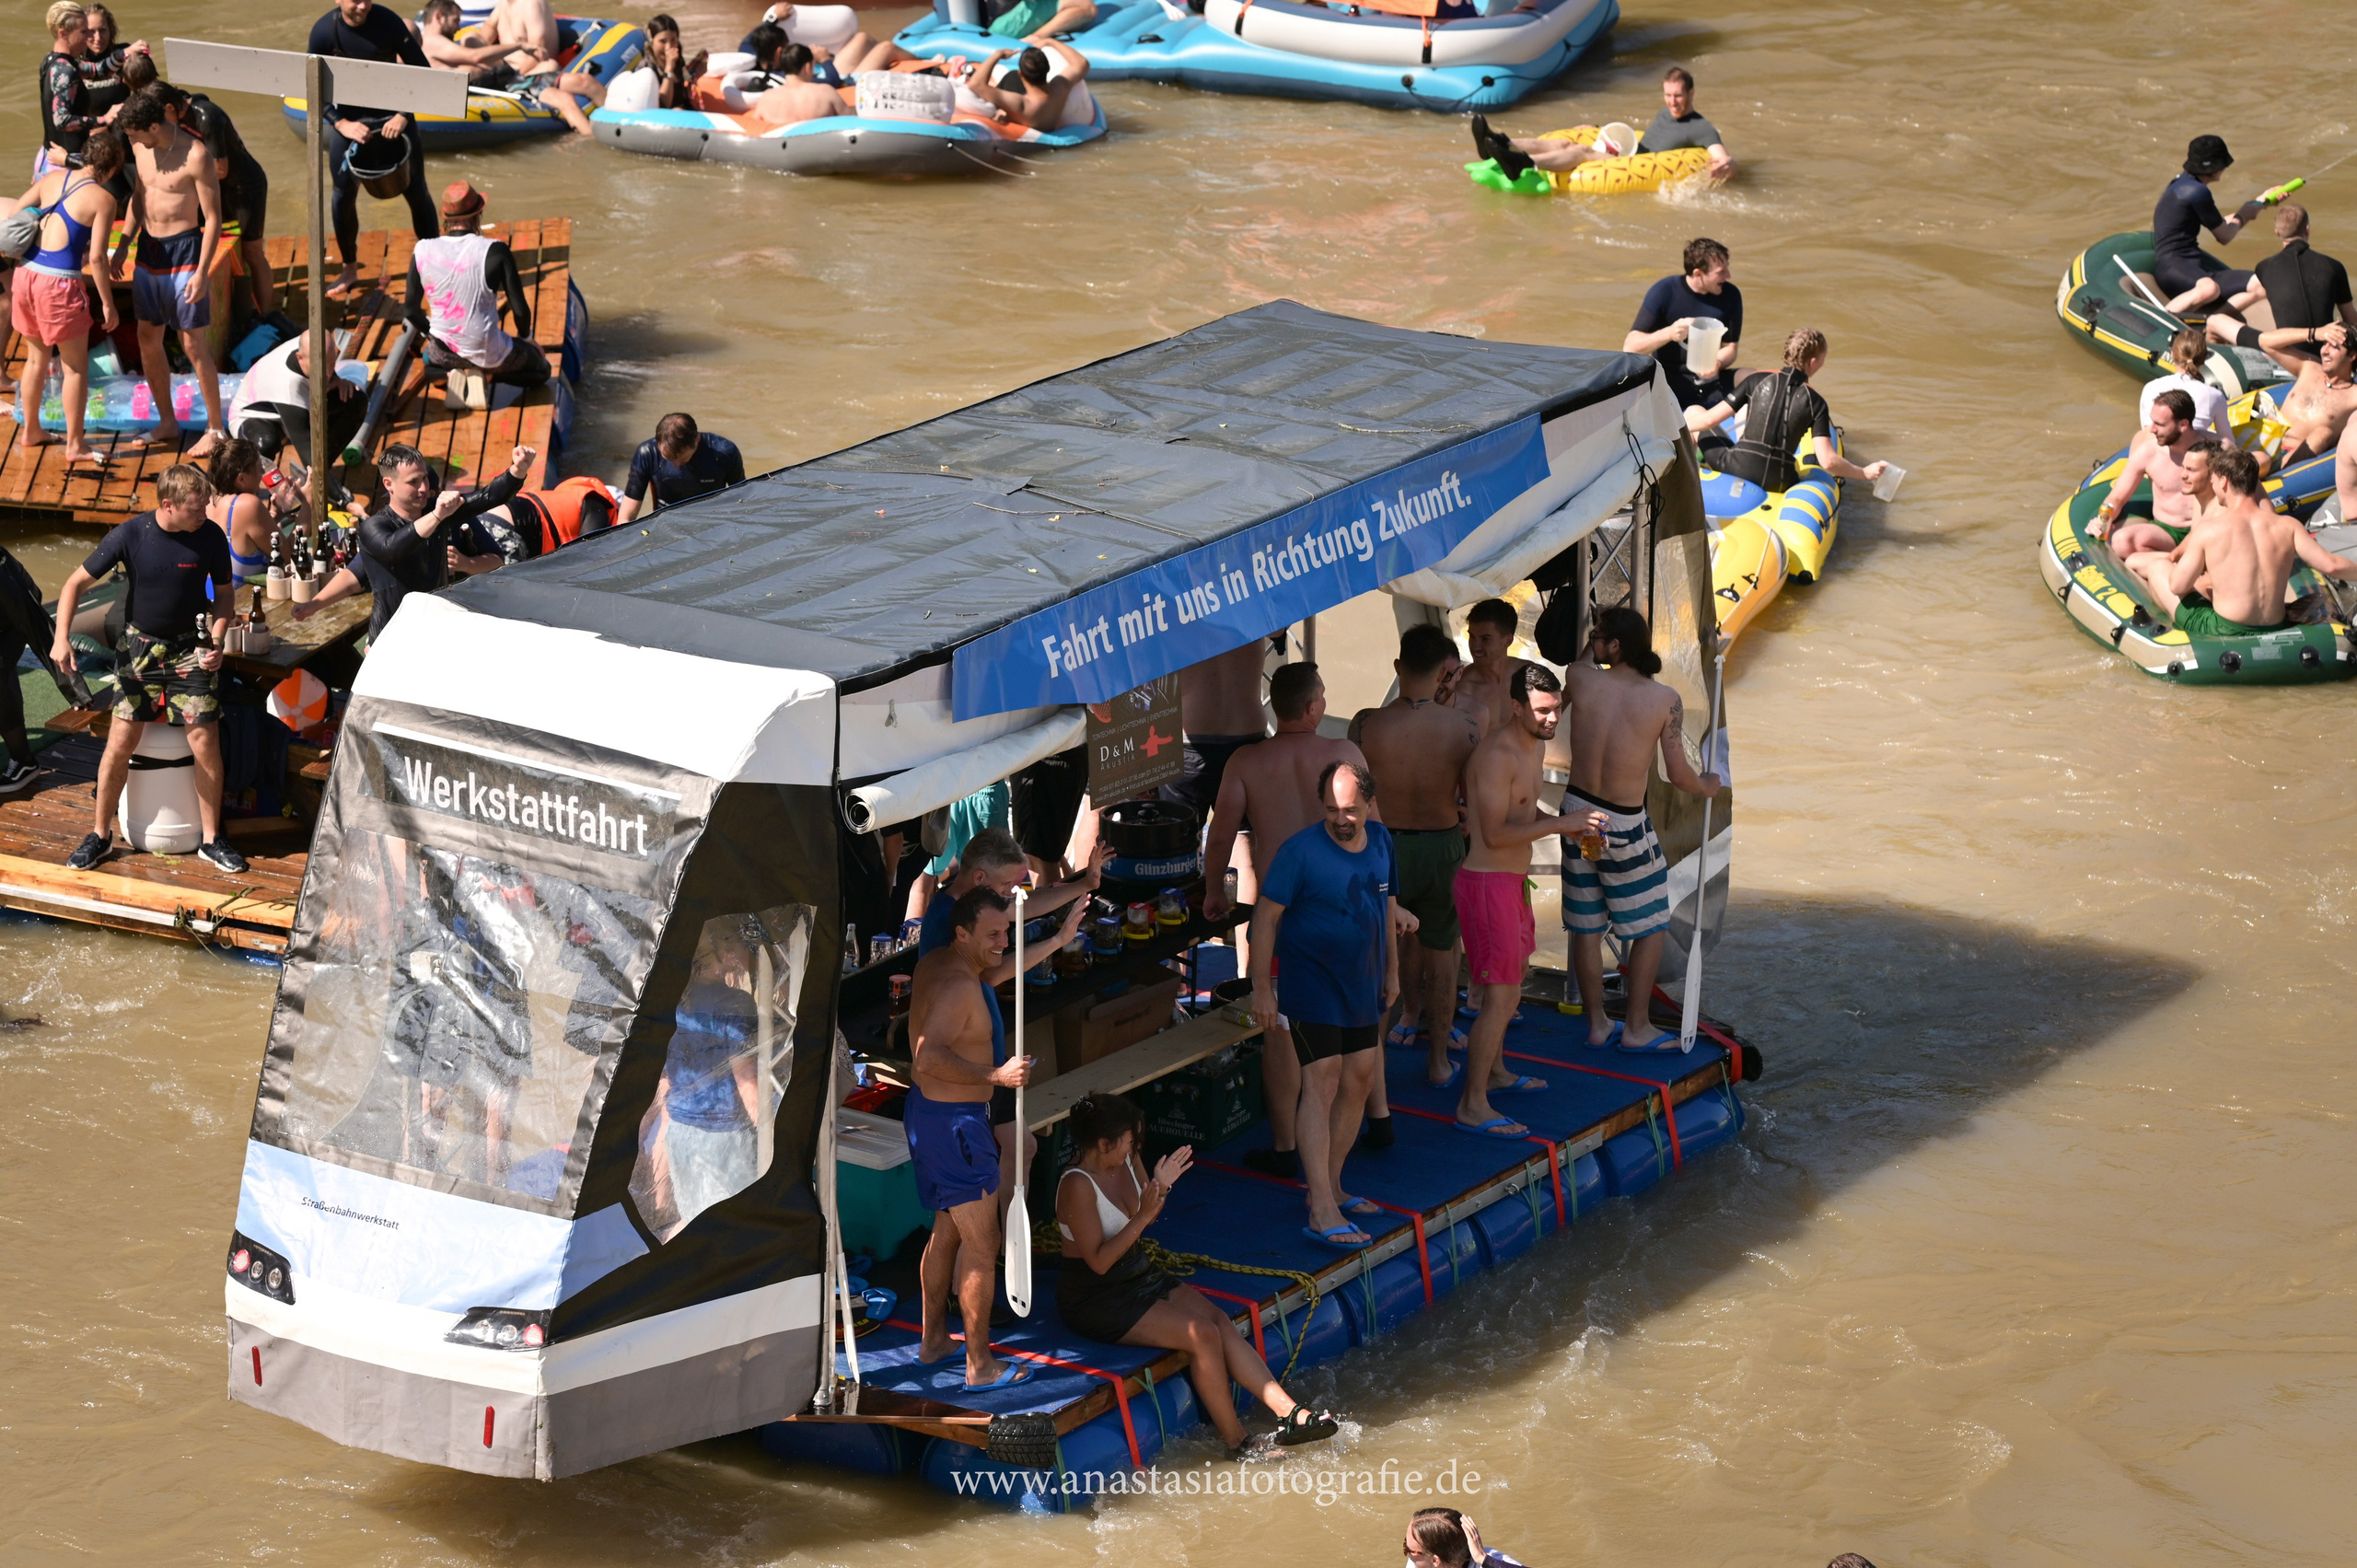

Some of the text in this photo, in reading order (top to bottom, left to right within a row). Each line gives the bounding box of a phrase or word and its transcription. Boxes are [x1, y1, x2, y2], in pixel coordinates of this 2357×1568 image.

[1041, 470, 1472, 678] Fahrt mit uns in Richtung Zukunft.
[1100, 737, 1134, 761] D & M
[1100, 753, 1135, 772] Akustik
[224, 791, 252, 811] Spzi
[404, 756, 648, 856] Werkstattfahrt
[1134, 856, 1197, 876] Günzburger
[301, 1196, 400, 1230] Straßenbahnwerkstatt
